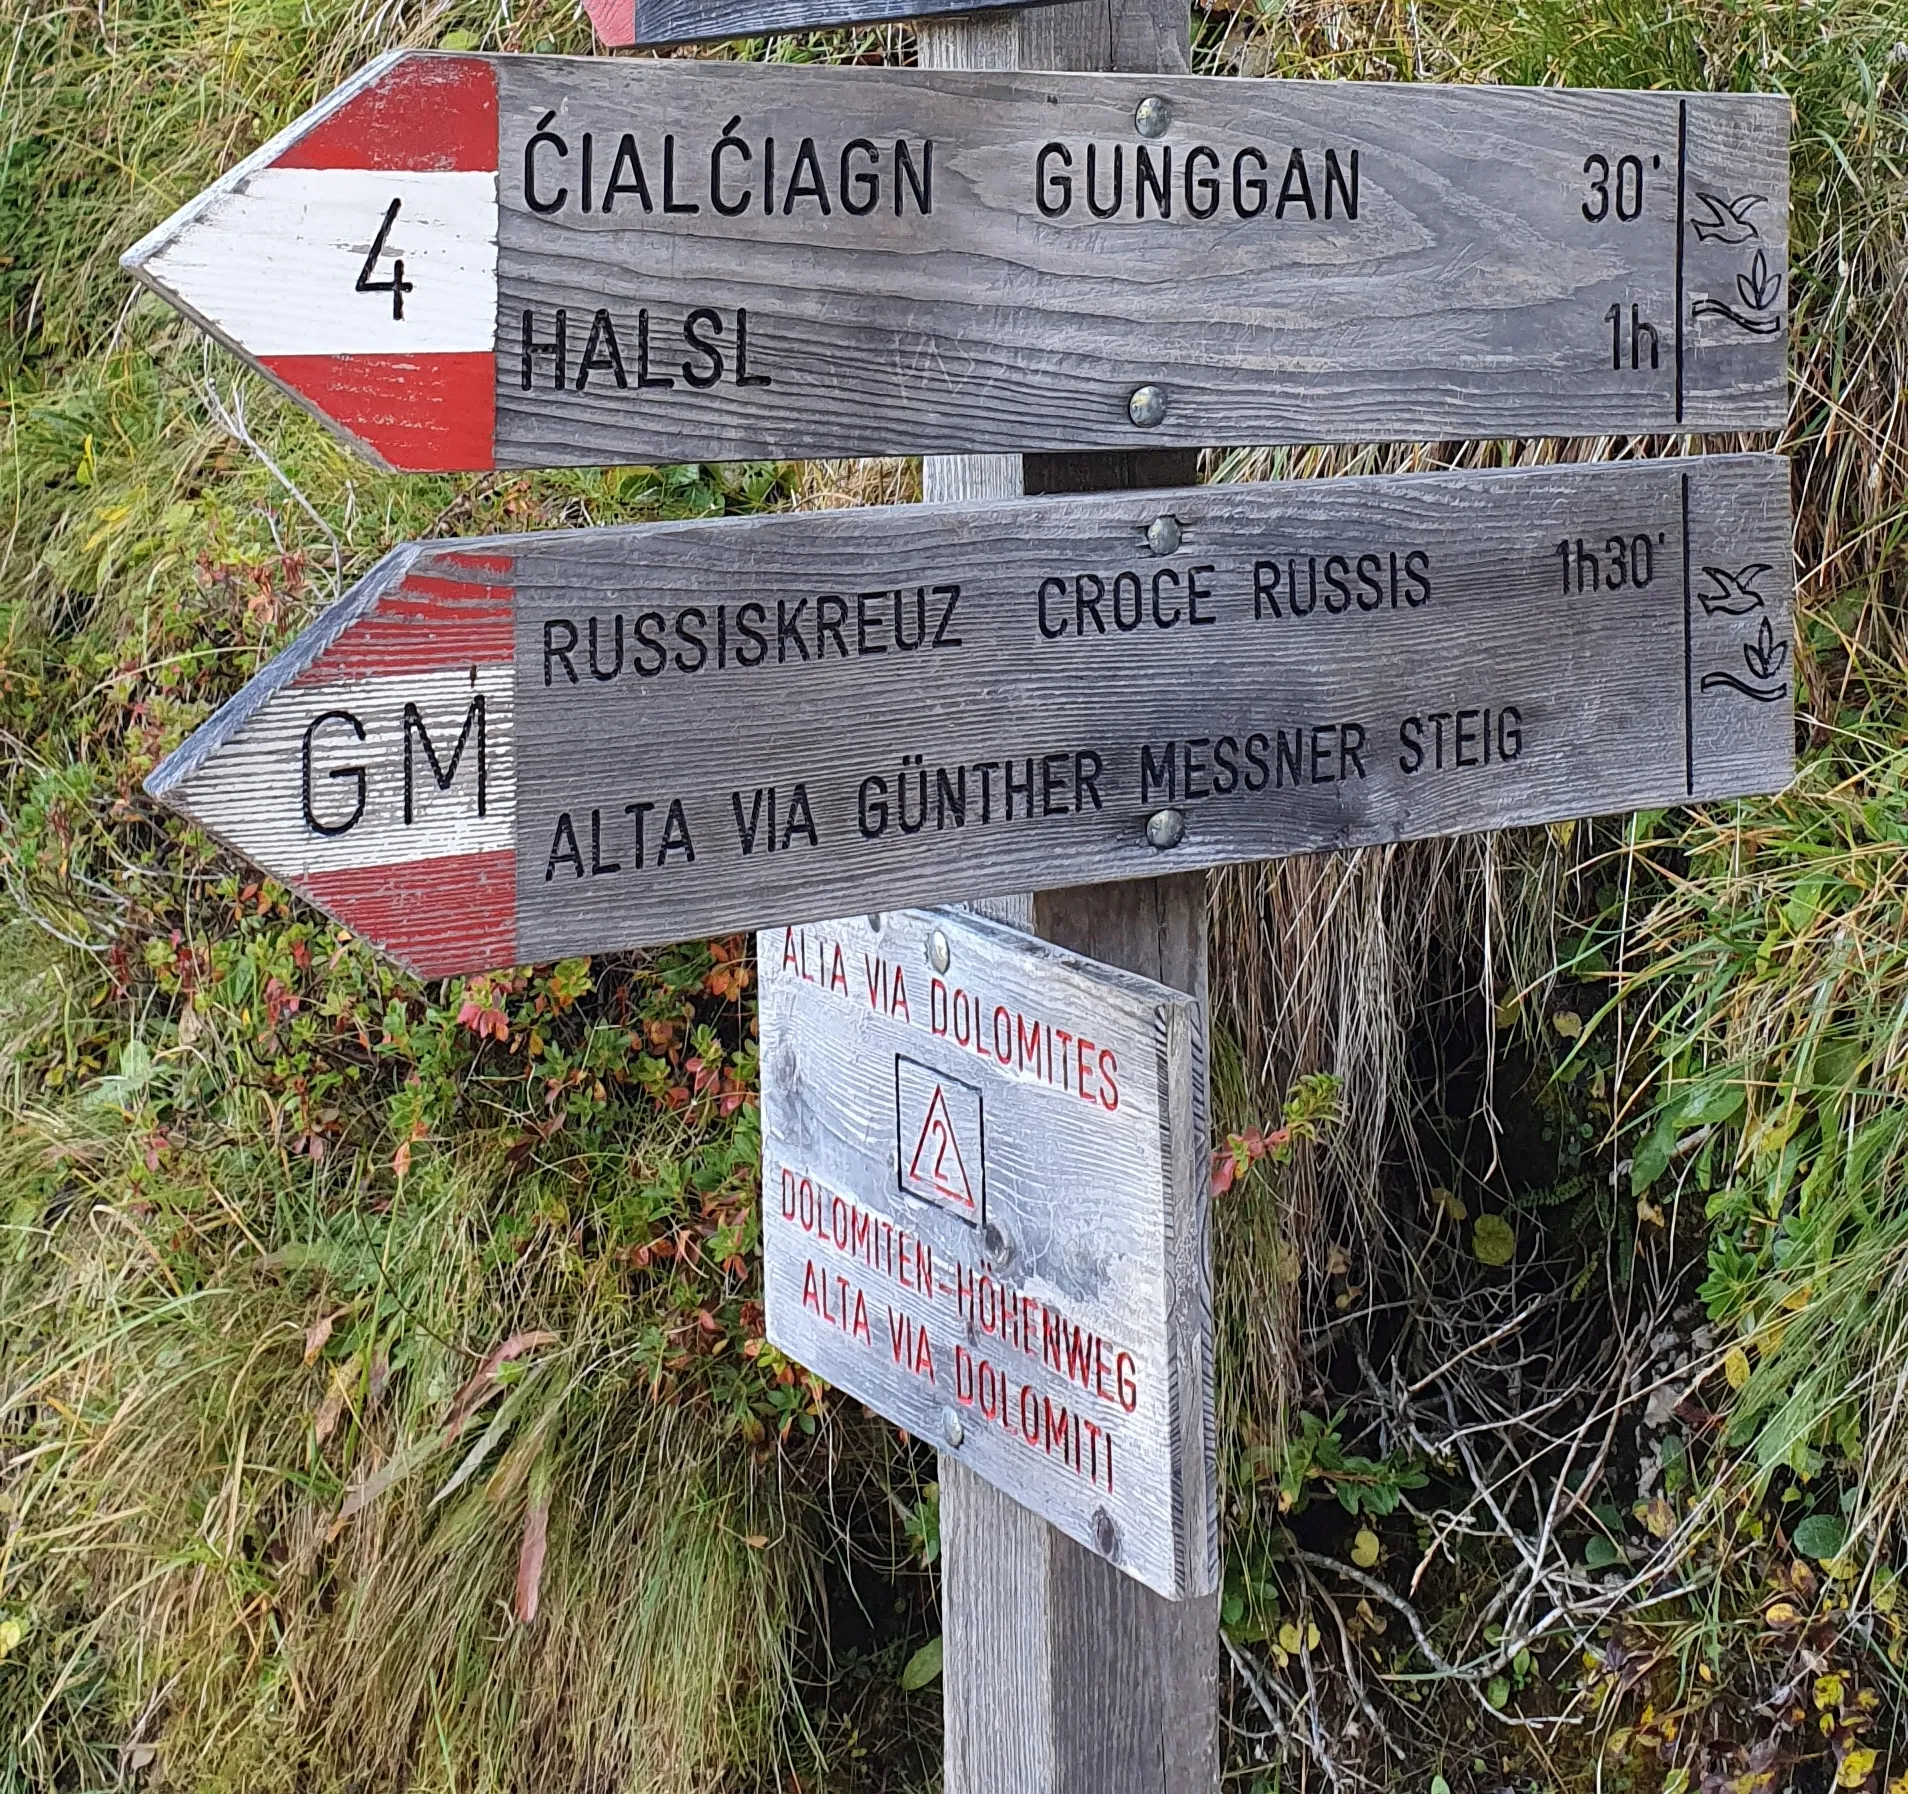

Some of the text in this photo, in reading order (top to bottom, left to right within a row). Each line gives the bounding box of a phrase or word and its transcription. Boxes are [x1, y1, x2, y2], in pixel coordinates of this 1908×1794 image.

[523, 110, 934, 216] ĆIALĆIAGN
[1034, 141, 1360, 222] GUNGGAN
[355, 197, 413, 321] 4
[521, 307, 772, 394] HALSL
[1604, 302, 1660, 372] 1h
[543, 584, 964, 687] RUSSISKREUZ
[1037, 549, 1432, 641] CROCE RUSSIS
[301, 693, 488, 837] GM
[545, 705, 1525, 883] ALTA VIA GÜNTHER MESSNER STEIG
[782, 926, 1120, 1112] ALTA VIA DOLOMITES
[931, 1119, 949, 1181] 2
[802, 1258, 1114, 1495] ALTA VIA DOLOMITI
